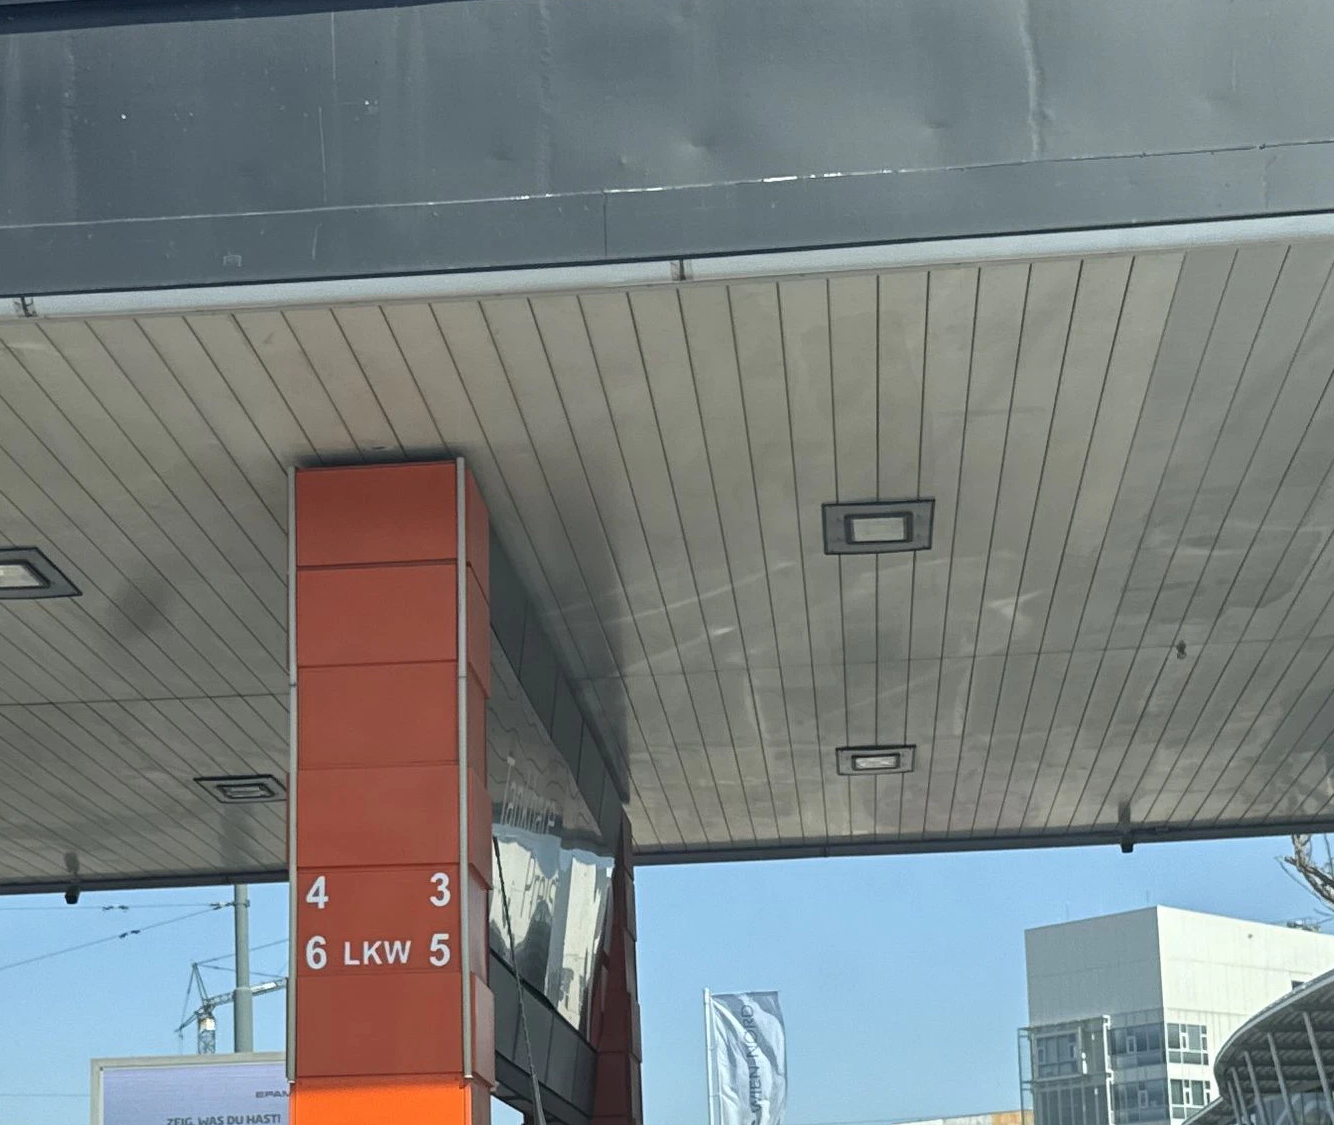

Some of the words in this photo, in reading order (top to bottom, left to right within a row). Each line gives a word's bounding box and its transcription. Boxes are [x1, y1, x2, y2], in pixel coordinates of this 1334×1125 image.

[305, 875, 329, 909] 4
[429, 872, 452, 907] 3
[305, 936, 328, 970] 6
[343, 940, 411, 966] LKW
[429, 933, 451, 968] 5
[227, 1115, 244, 1125] DU
[246, 1114, 281, 1125] HAST!
